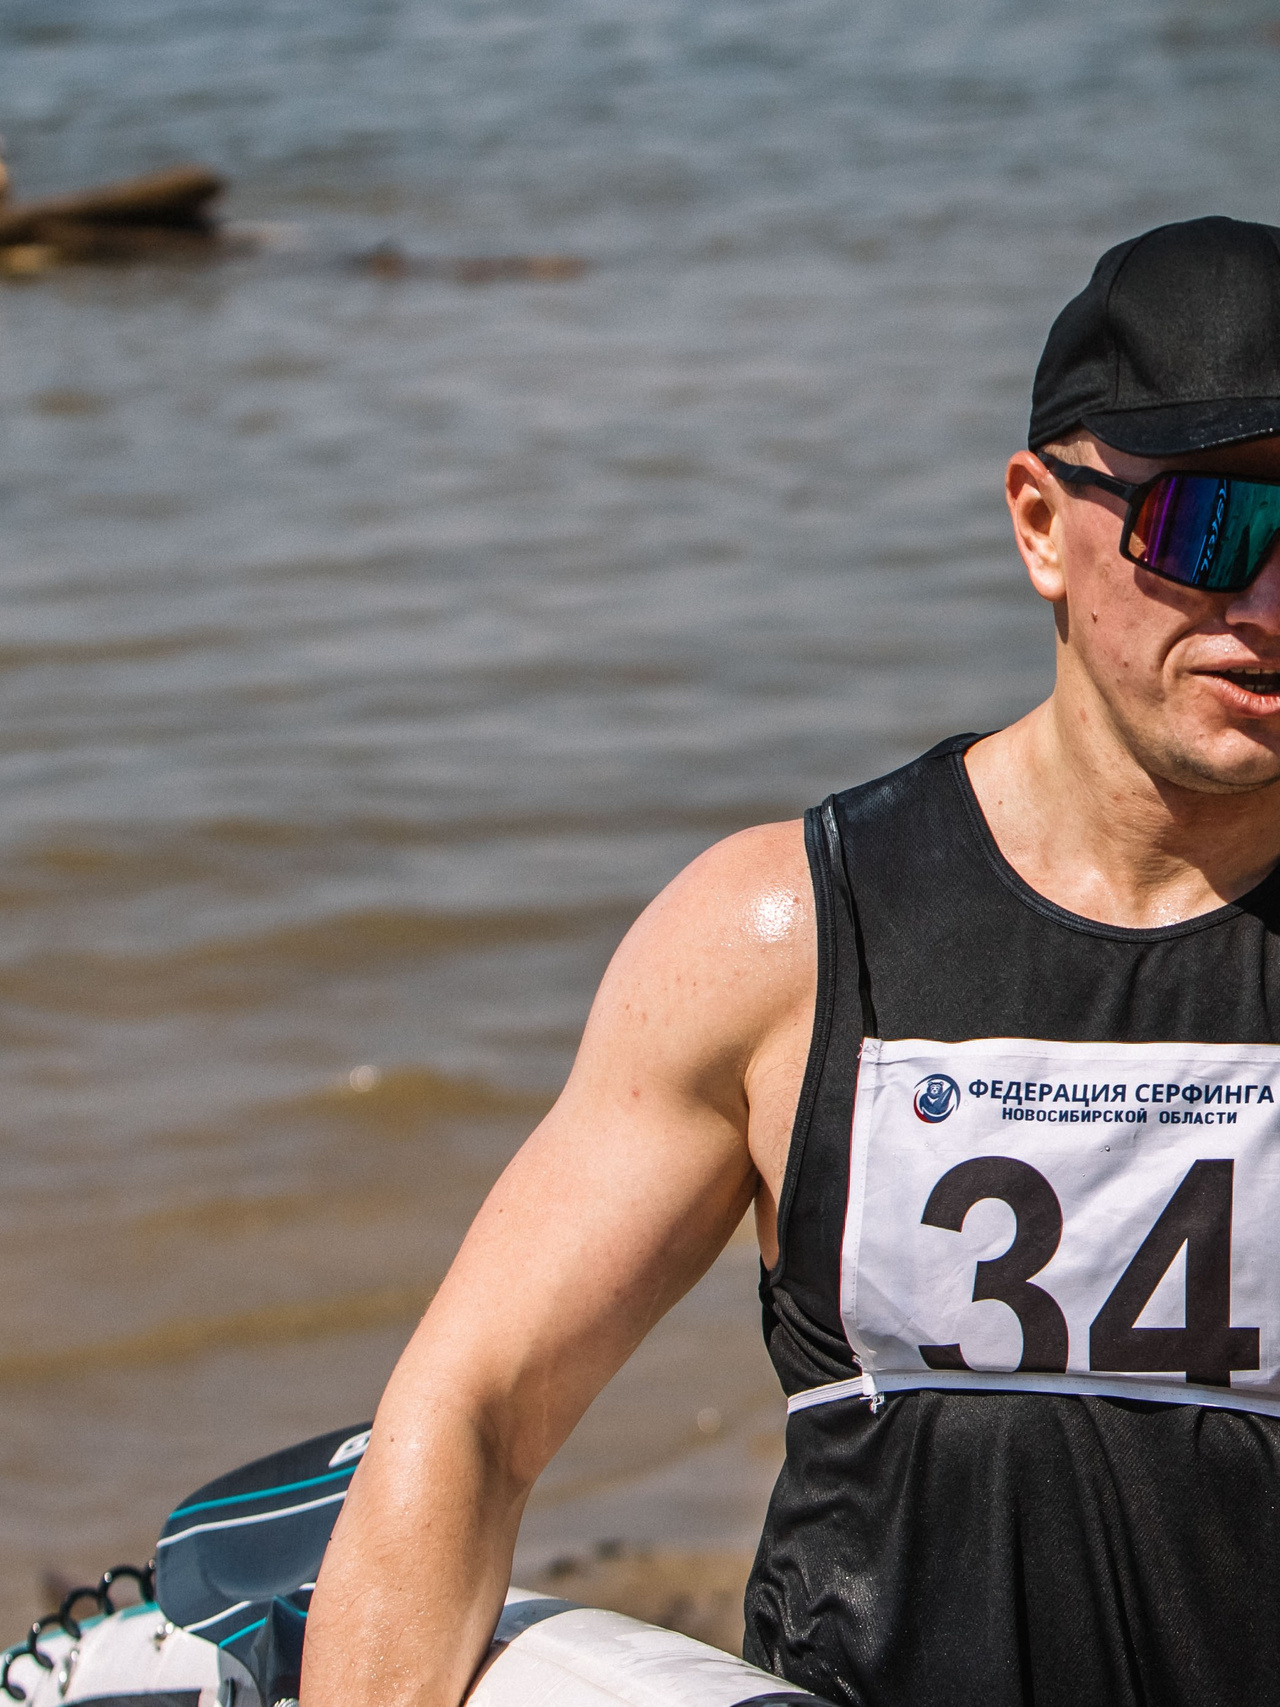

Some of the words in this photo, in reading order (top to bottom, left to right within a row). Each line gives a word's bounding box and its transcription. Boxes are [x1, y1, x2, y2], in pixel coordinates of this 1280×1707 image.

[968, 1079, 1126, 1105] ФЕДЕРАЦИЯ
[1135, 1083, 1275, 1104] СЕРФИНГА
[1002, 1107, 1148, 1124] НОВОСИБИРСКОЙ
[1159, 1110, 1238, 1125] ОБЛАСТИ
[918, 1156, 1260, 1388] 34
